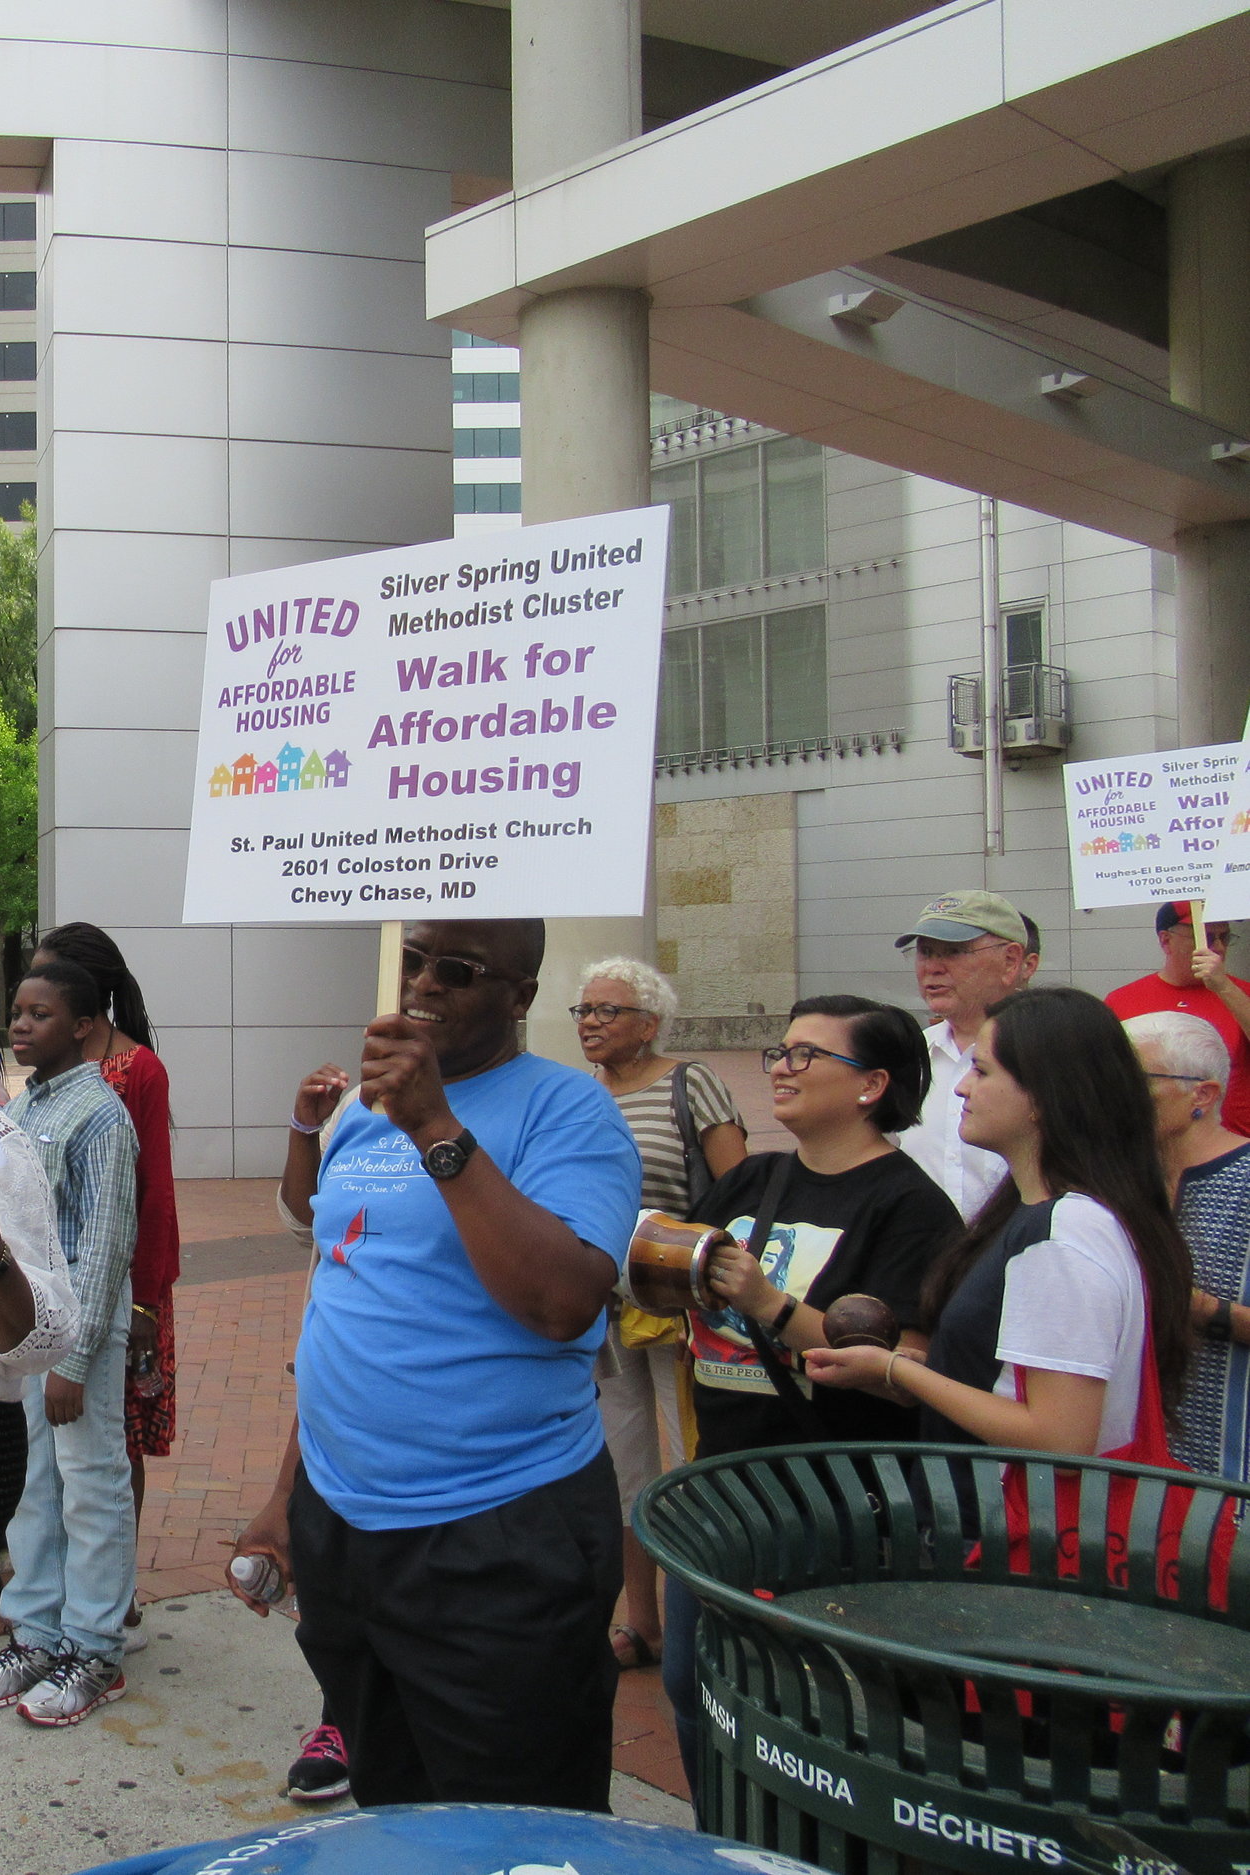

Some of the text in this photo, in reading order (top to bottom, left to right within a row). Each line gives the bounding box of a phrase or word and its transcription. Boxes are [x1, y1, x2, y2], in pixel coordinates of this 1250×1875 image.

[380, 538, 642, 600] Silver Spring United
[388, 586, 624, 637] Methodist Cluster
[225, 597, 360, 653] UNITED
[267, 640, 303, 679] for
[396, 642, 595, 692] Walk for
[218, 671, 356, 708] AFFORDABLE
[236, 703, 330, 733] HOUSING
[367, 696, 617, 749] Affordable
[1162, 760, 1199, 774] Silver
[1203, 756, 1239, 773] Sprin
[388, 757, 581, 800] Housing
[1075, 771, 1153, 795] UNITED
[1169, 771, 1235, 789] Methodist
[1077, 801, 1157, 819] AFFORDABLE
[1104, 789, 1124, 806] for
[1090, 814, 1145, 829] HOUSING
[230, 817, 592, 853] St. Paul United Methodist Church
[1183, 838, 1220, 853] Ho
[281, 852, 499, 877] 2601 Coloston Drive
[1155, 864, 1184, 875] Buen
[1128, 873, 1211, 887] 10700 Georgia
[1150, 885, 1205, 897] Wheaton,
[291, 881, 476, 906] Chevy Chase, MD
[352, 1156, 415, 1172] Methodist
[390, 1182, 408, 1193] MD
[714, 1366, 732, 1376] THE
[701, 1682, 737, 1740] TRASH
[755, 1733, 854, 1806] BASURA
[893, 1797, 1063, 1866] DÉCHETS
